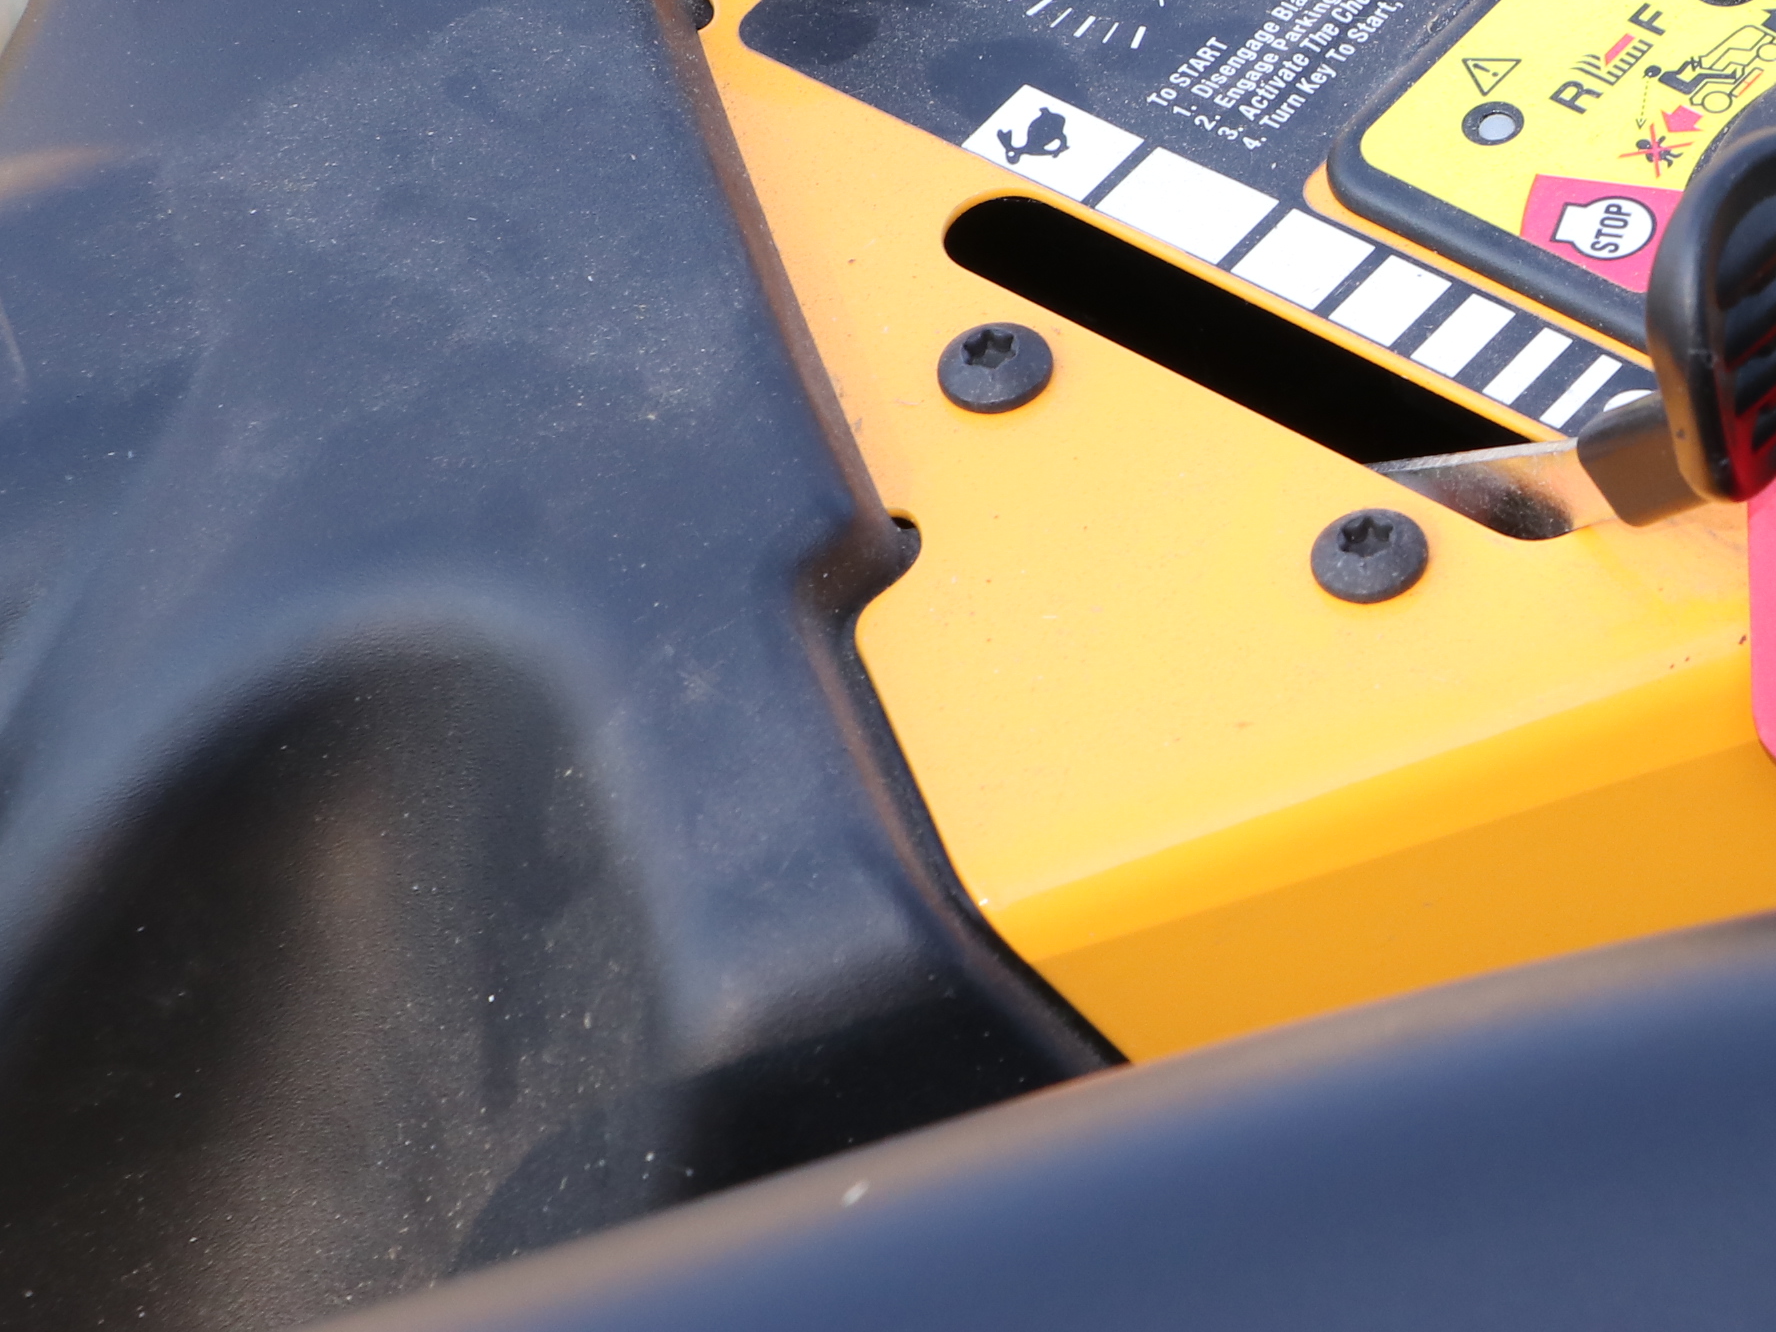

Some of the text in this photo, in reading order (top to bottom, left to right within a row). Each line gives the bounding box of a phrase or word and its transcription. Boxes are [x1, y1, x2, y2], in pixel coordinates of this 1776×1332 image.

[1145, 35, 1229, 107] To START
[1189, 20, 1281, 102] Disengage
[1212, 51, 1280, 110] Engage
[1237, 52, 1311, 122] Activate
[1298, 21, 1341, 54] The
[1257, 93, 1307, 130] Turn
[1294, 62, 1338, 95] Key
[1324, 42, 1357, 63] To
[1346, 0, 1405, 44] Start,
[1549, 2, 1667, 115] R F
[1590, 203, 1632, 254] STOP
